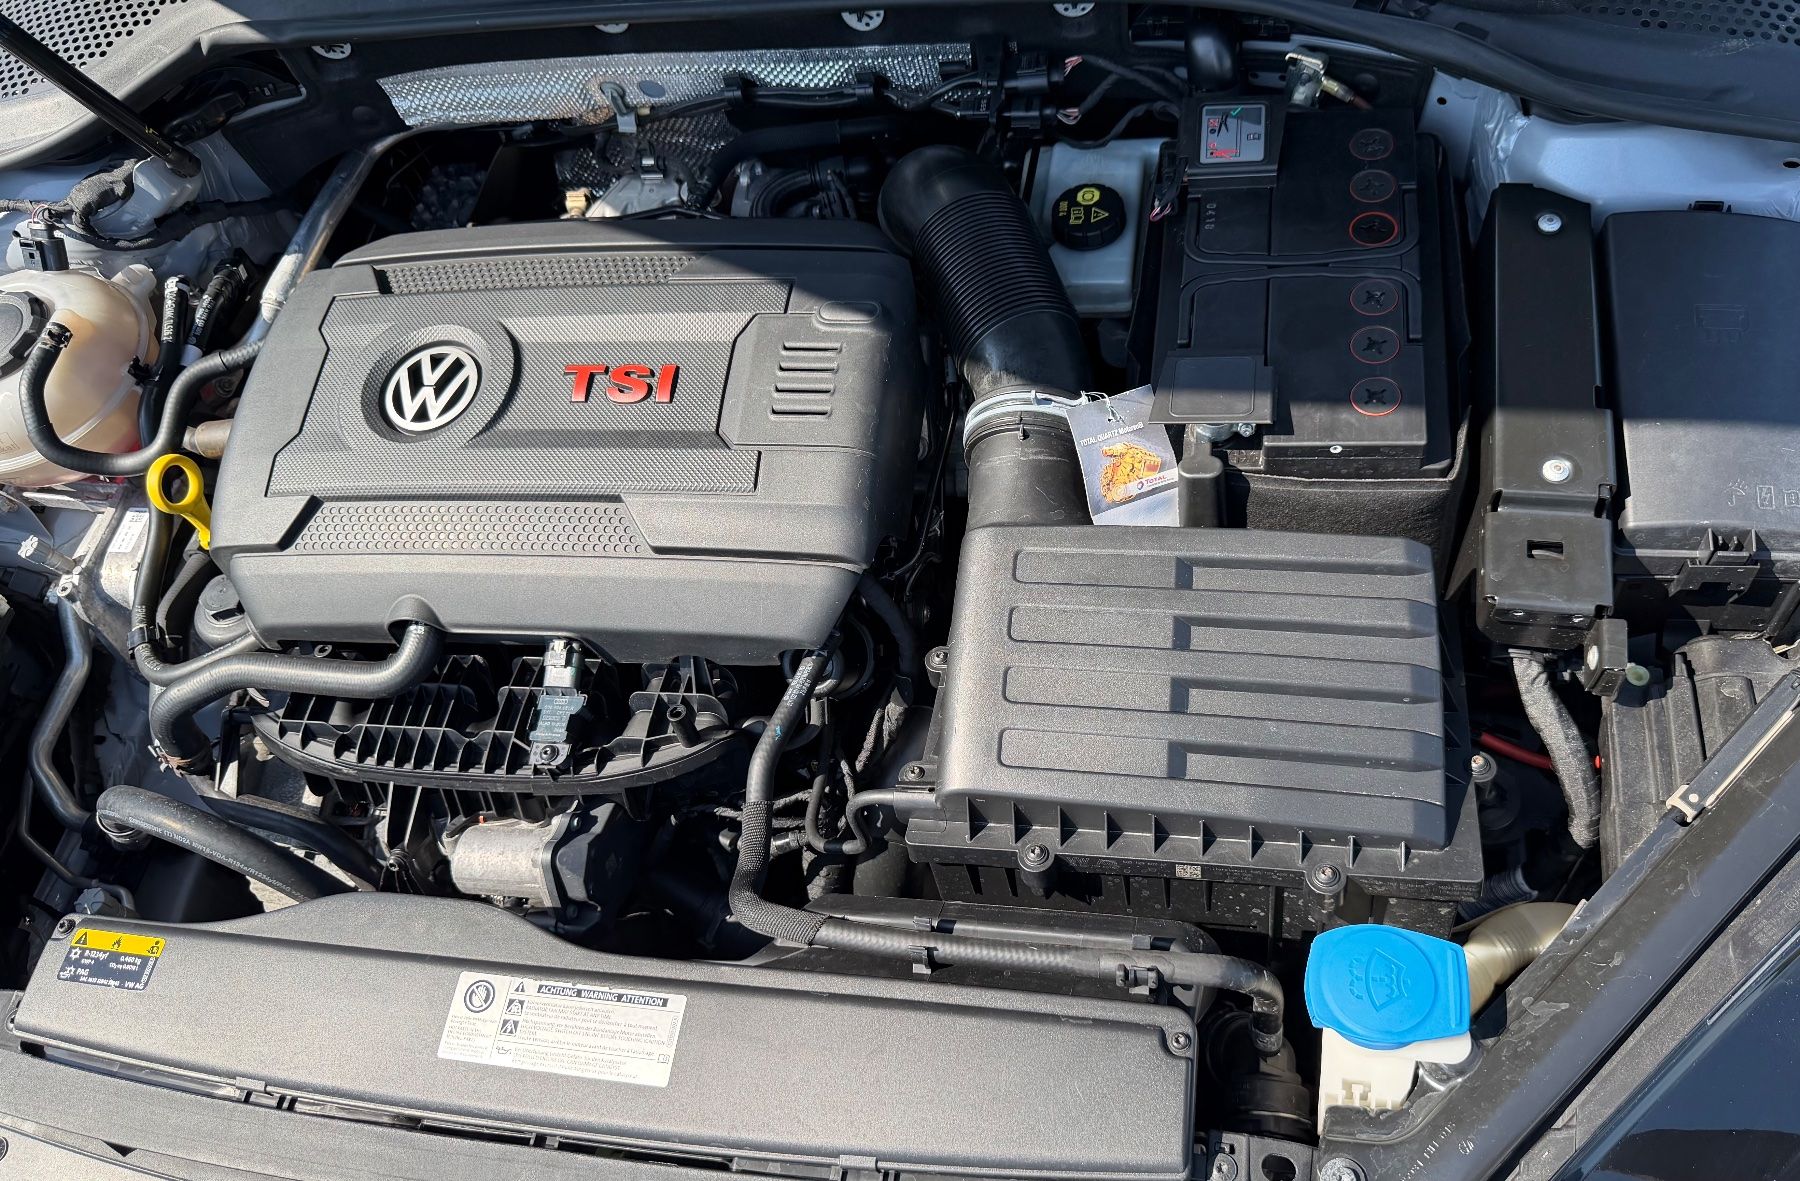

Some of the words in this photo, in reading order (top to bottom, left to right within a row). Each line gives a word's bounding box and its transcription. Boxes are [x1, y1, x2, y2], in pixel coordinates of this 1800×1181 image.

[564, 364, 679, 404] TSI
[1080, 436, 1098, 446] TOTAL
[1097, 429, 1119, 442] QUARTZ
[1145, 474, 1168, 485] TOTAL
[76, 968, 90, 976] PAG
[125, 981, 136, 989] VW
[539, 985, 578, 997] ACHTUNG
[581, 989, 619, 1001] WARNING
[620, 994, 664, 1006] ATTENTION
